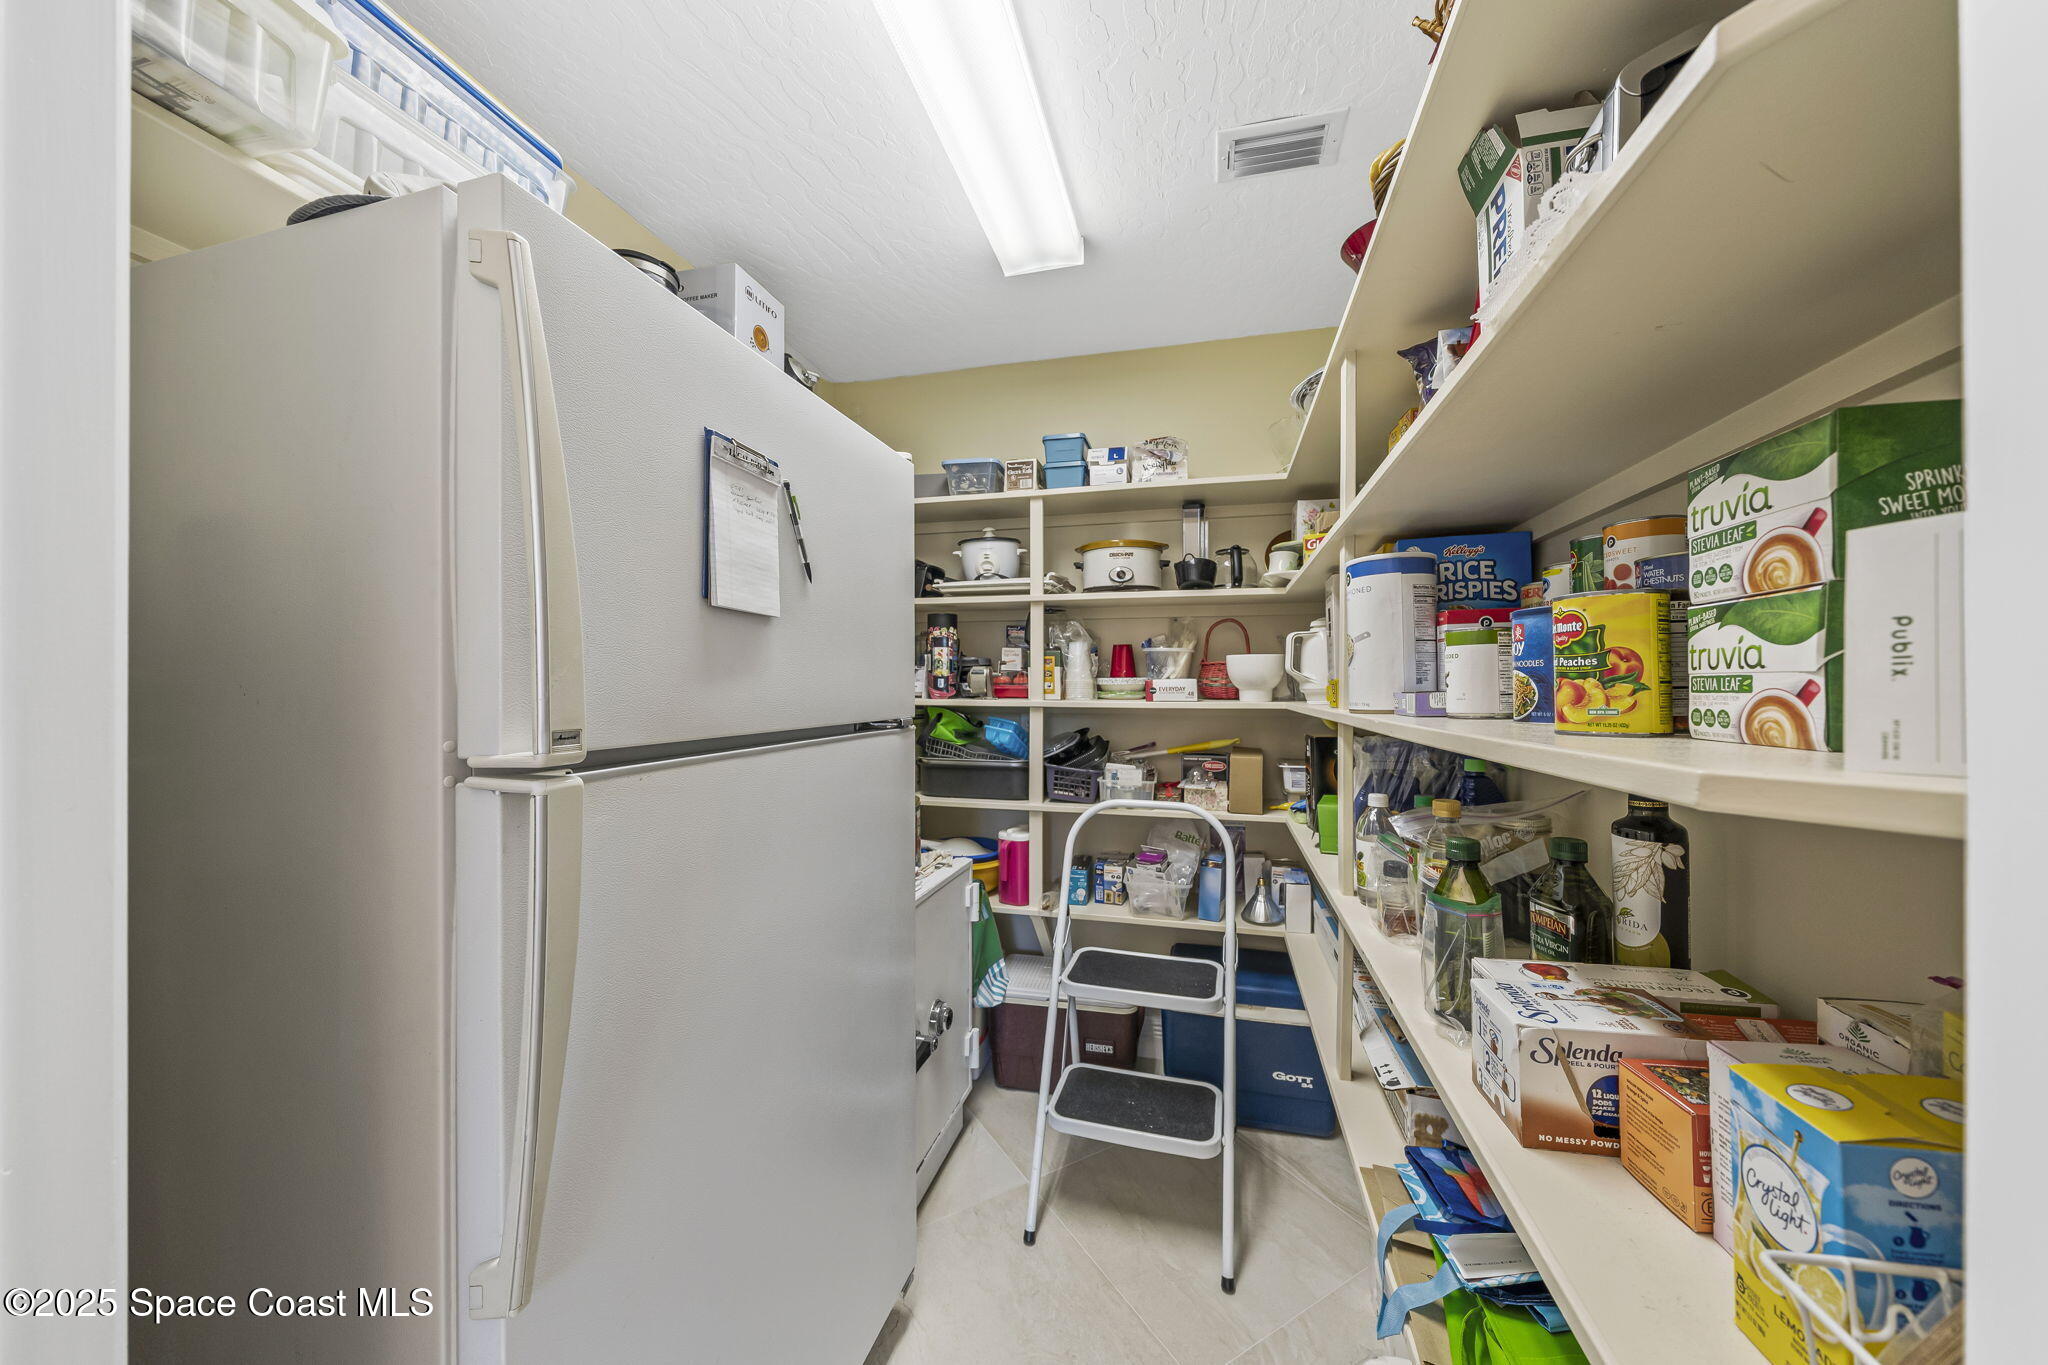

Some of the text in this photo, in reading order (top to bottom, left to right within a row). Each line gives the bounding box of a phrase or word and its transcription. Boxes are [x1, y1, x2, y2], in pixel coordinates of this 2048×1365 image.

[700, 292, 718, 300] MAKER
[1689, 463, 1721, 491] PLANT-BASED
[1878, 491, 1932, 516] SWEET
[1692, 526, 1746, 554] STEVIA LEAF
[1444, 544, 1486, 557] Kellogg's
[1439, 560, 1495, 582] RICE
[1643, 568, 1665, 578] WATER
[1643, 574, 1685, 585] CHESTNUTS
[1437, 579, 1518, 601] RISPIES
[1688, 608, 1717, 627] PLANT-BASED
[1556, 621, 1583, 633] Monte
[1891, 615, 1914, 677] Publix
[1560, 657, 1598, 666] Peaches
[1692, 677, 1742, 691] STEVIA LEAF
[1544, 938, 1569, 954] VIRGIN
[1085, 1042, 1114, 1054] HERSHEY'S
[1530, 1037, 1623, 1066] Splenda
[1838, 1032, 1880, 1060] ORGANIC
[1567, 1059, 1585, 1068] PEEL
[1594, 1061, 1617, 1069] POUR
[1591, 1088, 1602, 1098] 12
[1539, 1134, 1552, 1143] NO
[1555, 1135, 1587, 1146] MESSY
[1747, 1168, 1800, 1212] Crystal
[1888, 1200, 1943, 1211] DIRECTIONS
